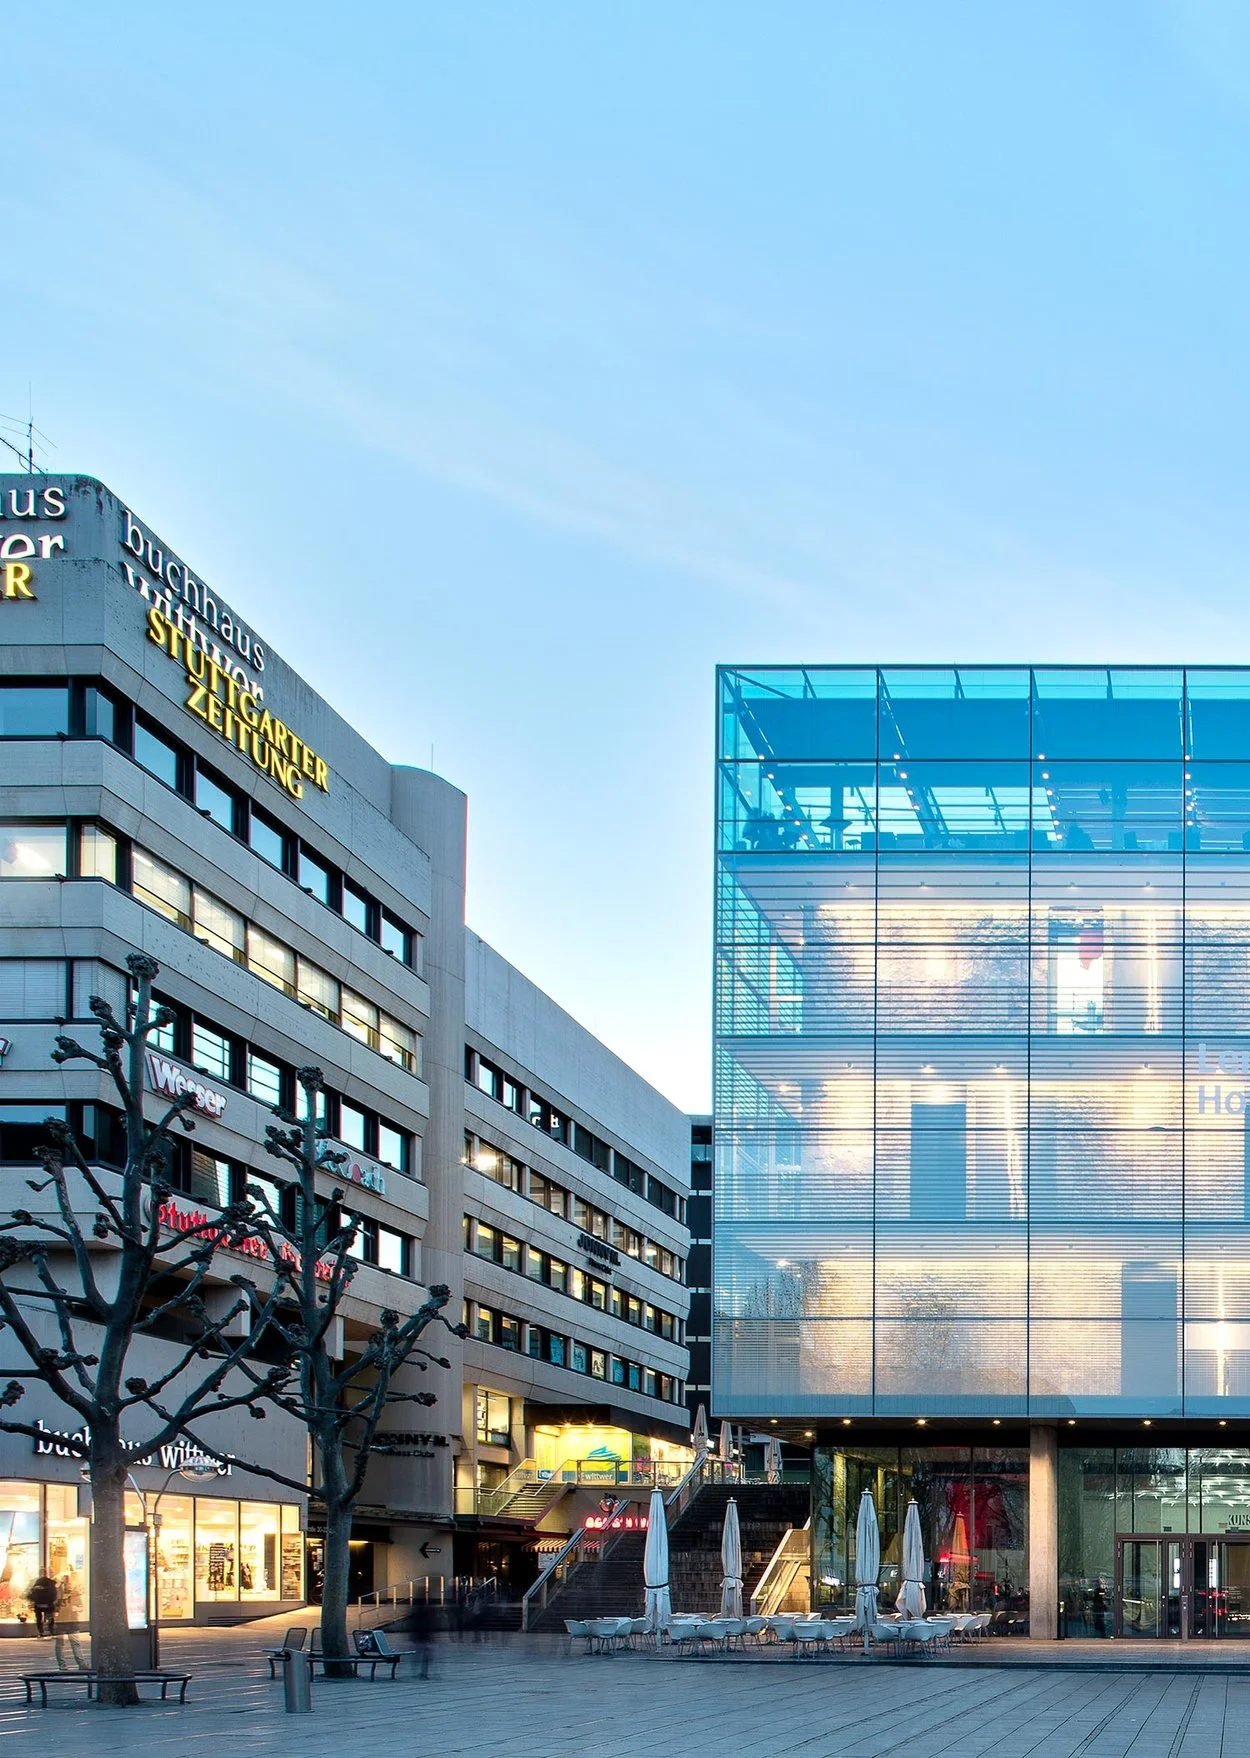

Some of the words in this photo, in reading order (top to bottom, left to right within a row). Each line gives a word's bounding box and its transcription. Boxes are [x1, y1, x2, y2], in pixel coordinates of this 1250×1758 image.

[0, 487, 65, 517] us
[122, 510, 265, 673] buchhaus
[149, 607, 330, 794] STUTTGARTER
[186, 675, 304, 800] ZEITUNG
